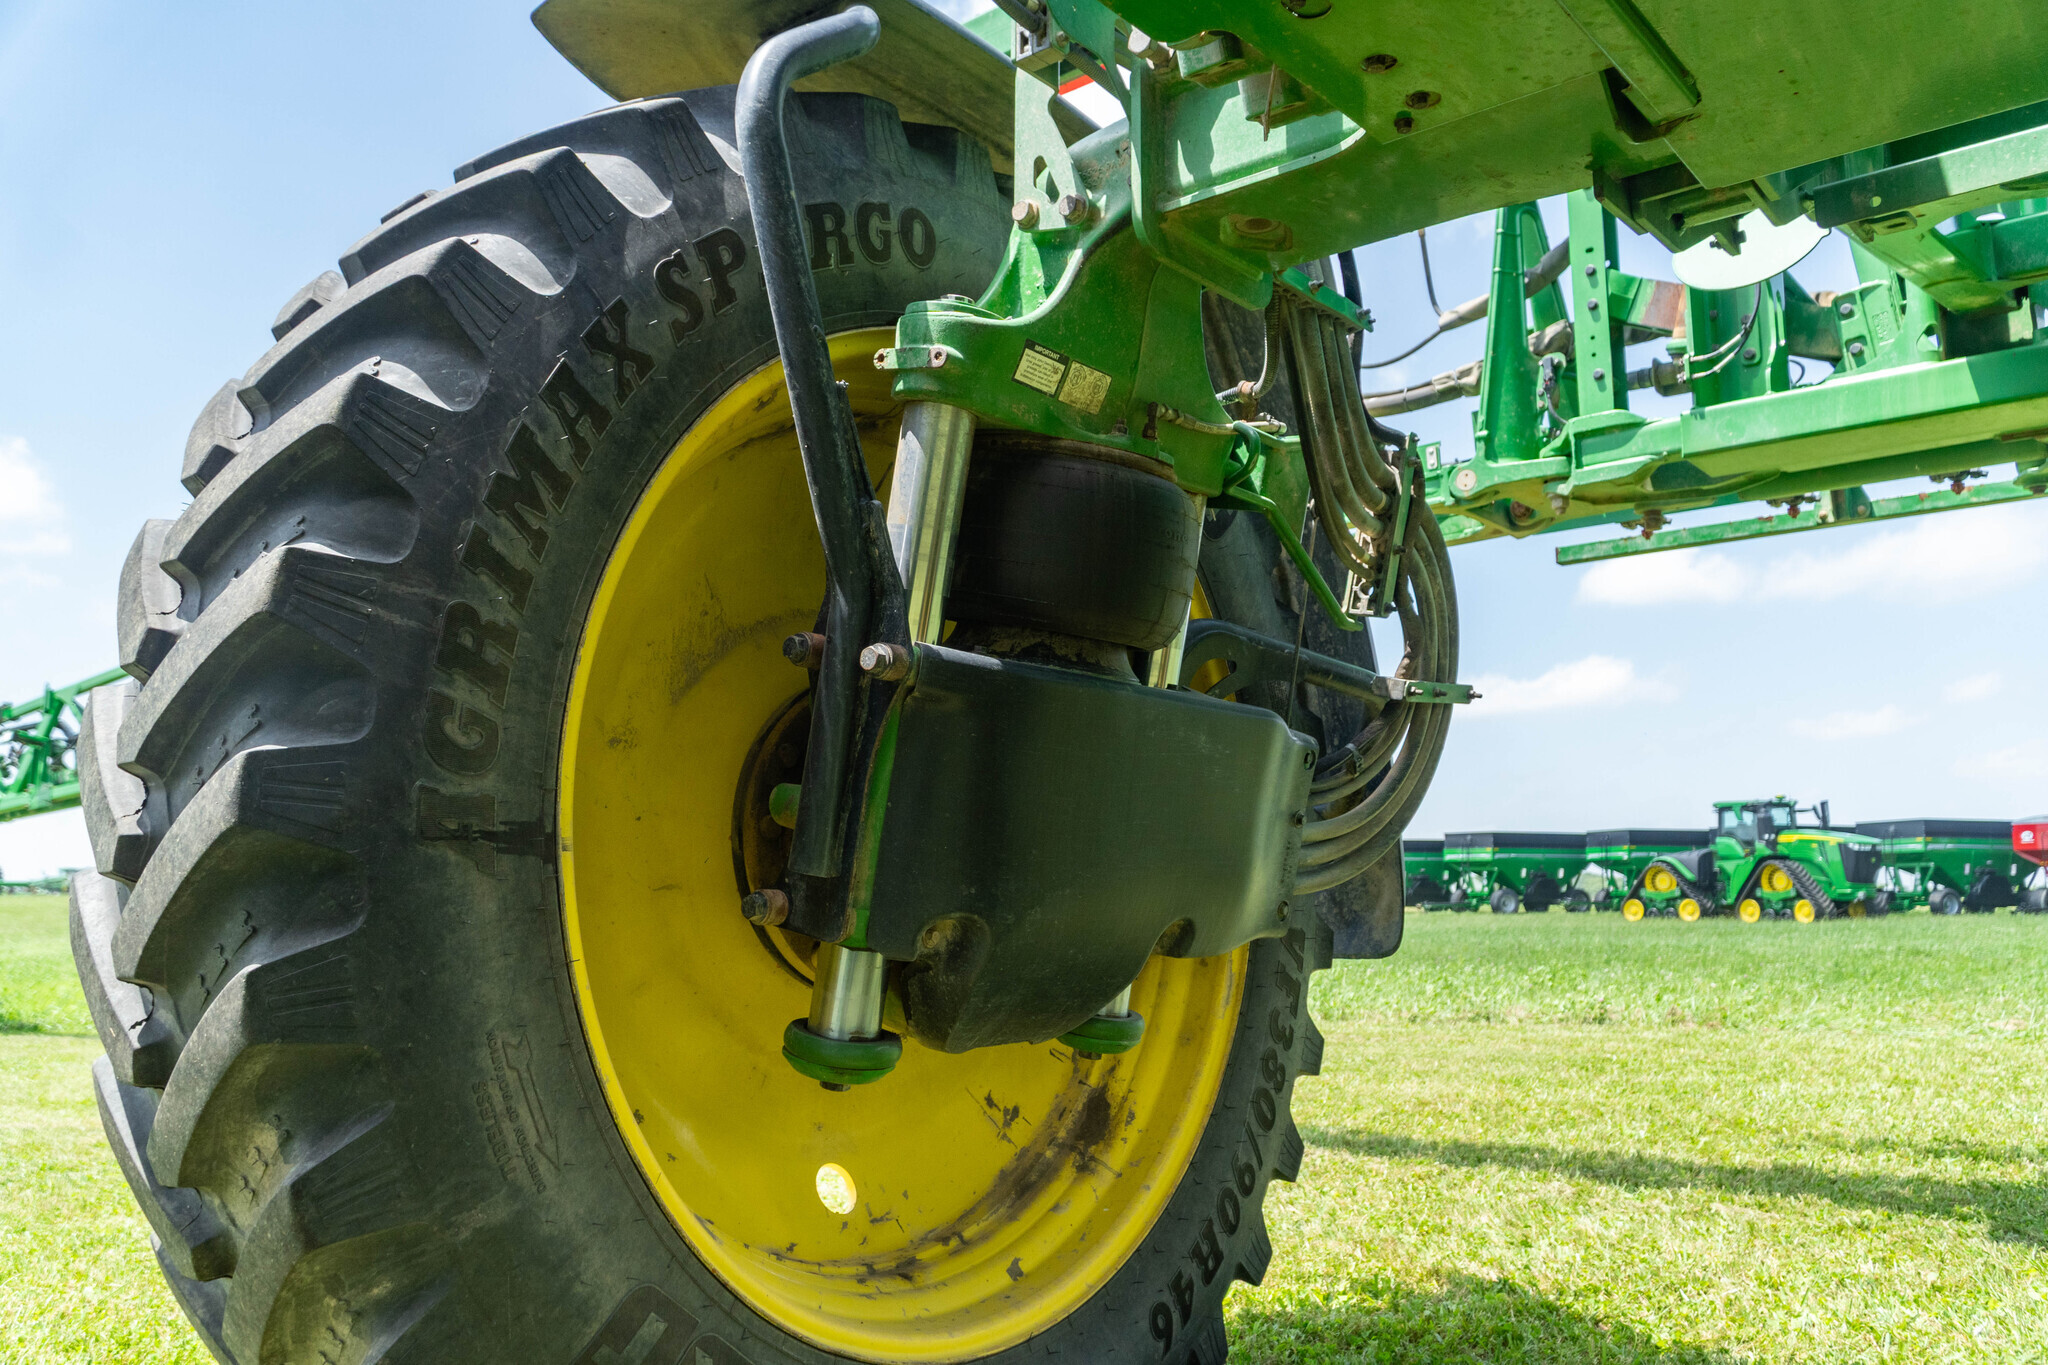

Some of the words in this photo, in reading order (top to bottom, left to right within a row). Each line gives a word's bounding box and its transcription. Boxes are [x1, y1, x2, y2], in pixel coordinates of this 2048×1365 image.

[1034, 344, 1060, 360] IMPORTANT
[415, 294, 656, 875] AGRIMAX
[653, 202, 937, 348] SPRGO
[485, 1031, 514, 1101] ROTATION
[472, 1079, 517, 1182] TUBELESS
[506, 1105, 520, 1123] OF
[513, 1125, 546, 1194] DIRECTION
